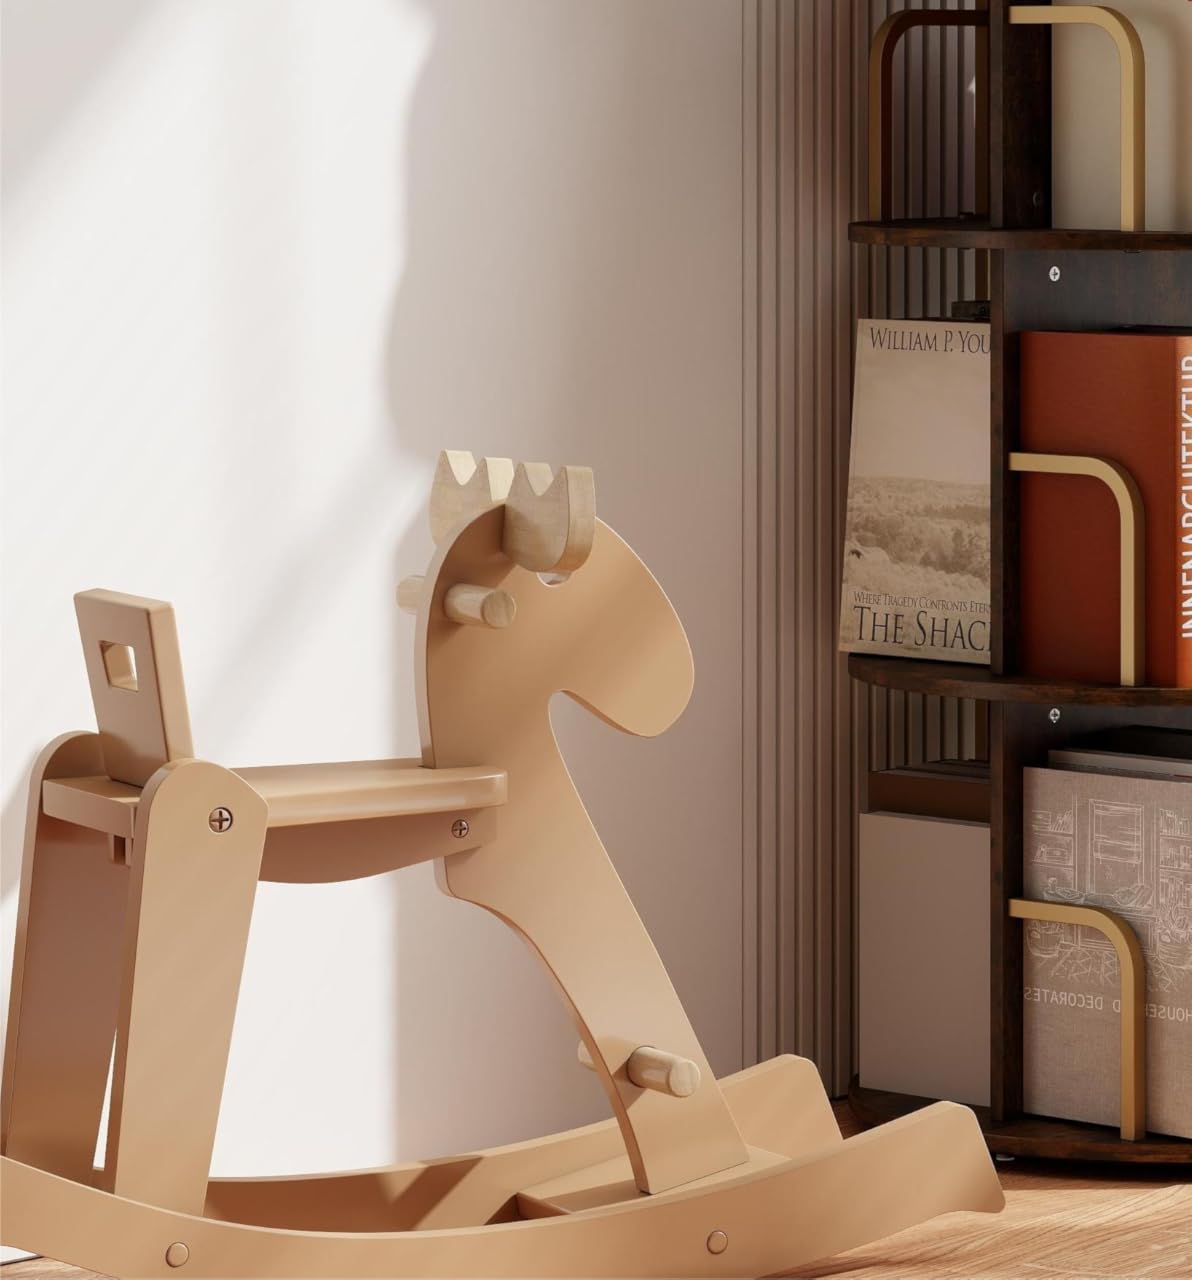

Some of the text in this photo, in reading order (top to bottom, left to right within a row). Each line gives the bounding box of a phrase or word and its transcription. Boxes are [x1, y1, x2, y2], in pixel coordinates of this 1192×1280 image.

[870, 327, 938, 352] WILLIAM
[943, 330, 953, 352] P.
[854, 591, 881, 605] WHERE
[883, 593, 919, 608] TRAGEDY
[919, 597, 968, 612] CONFRONTS
[853, 605, 904, 644] THE
